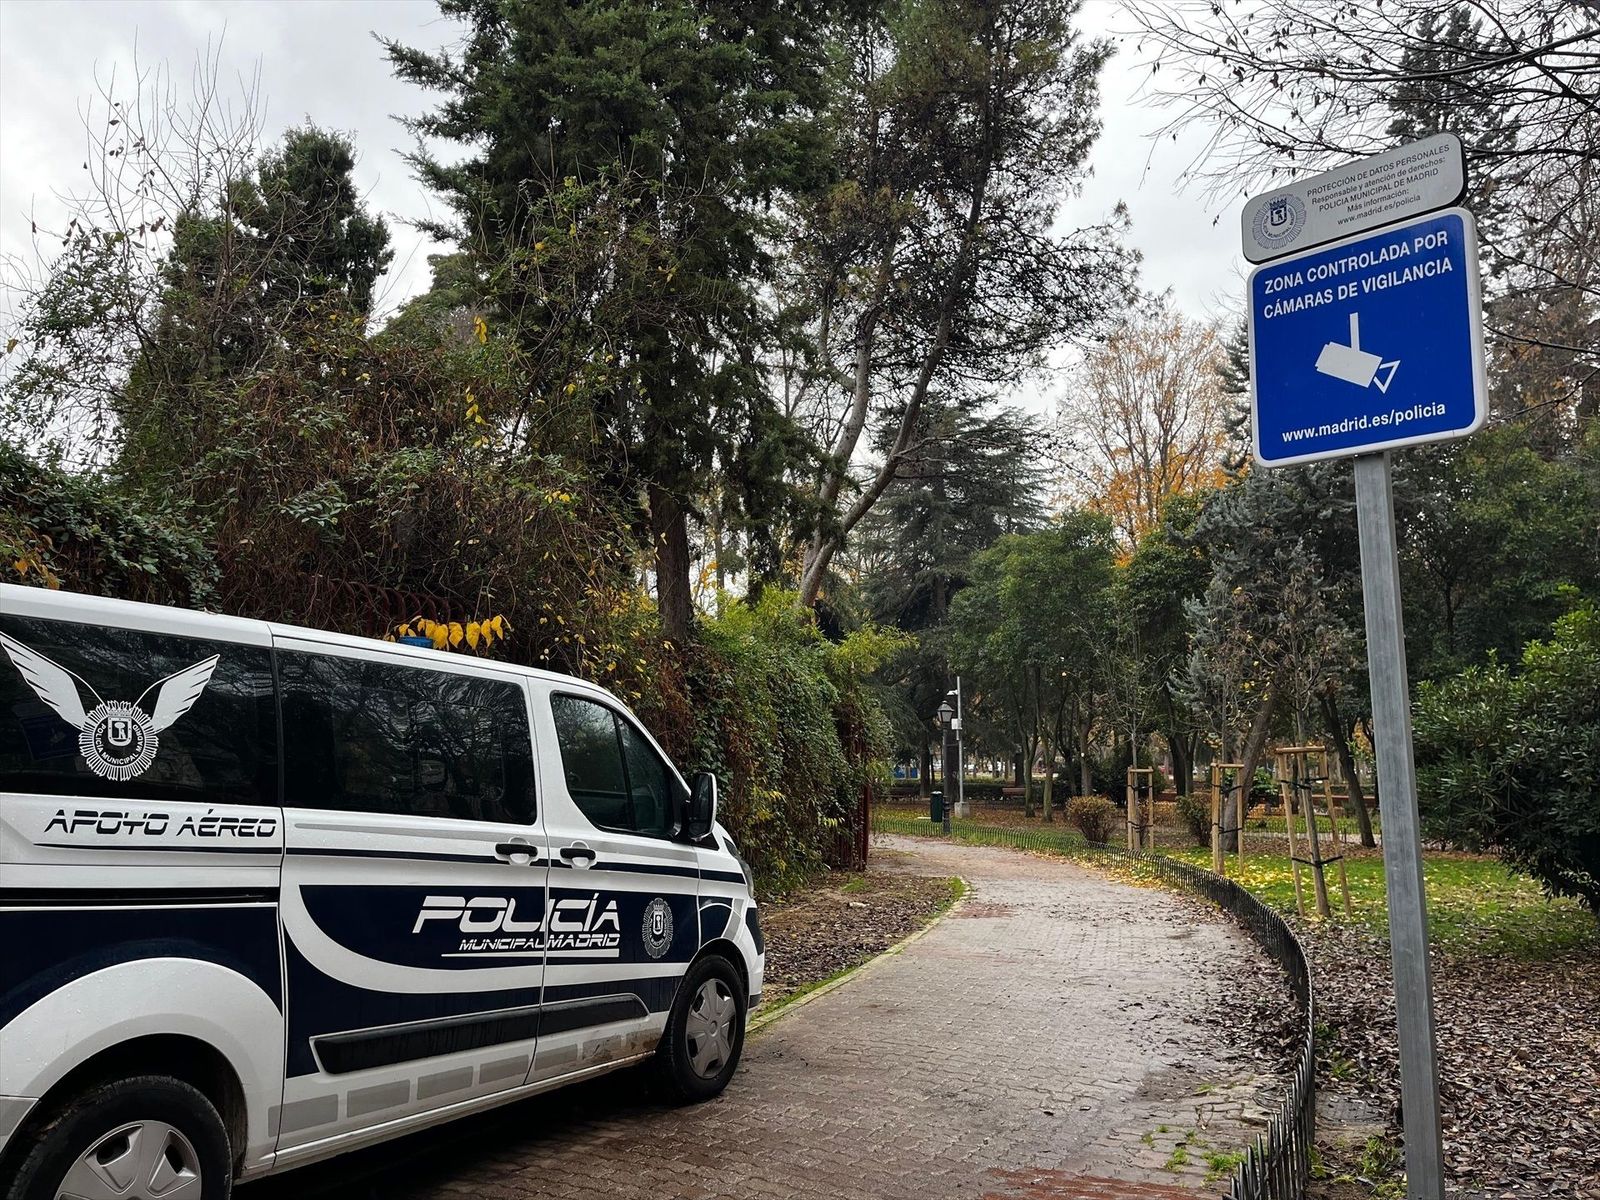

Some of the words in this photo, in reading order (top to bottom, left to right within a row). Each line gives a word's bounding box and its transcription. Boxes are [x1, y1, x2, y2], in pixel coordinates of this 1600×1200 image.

[1307, 175, 1356, 197] PROTECCIÓN
[1357, 170, 1368, 181] DE
[1369, 164, 1395, 177] DATOS
[1396, 144, 1450, 168] PERSONALES
[1311, 186, 1358, 205] Responsable
[1364, 173, 1396, 188] atención
[1397, 170, 1407, 178] de
[1408, 156, 1446, 174] derechos:
[1319, 197, 1349, 212] POLICIA
[1350, 184, 1393, 202] MUNICIPAL
[1394, 178, 1405, 188] DE
[1406, 168, 1439, 184] MADRID
[1337, 195, 1421, 225] www.madrid.es/policia
[1347, 203, 1363, 213] Más
[1364, 189, 1410, 208] información:
[1264, 274, 1304, 295] ZONA
[1306, 241, 1410, 283] CONTROLADA
[1414, 230, 1448, 253] POR
[1263, 288, 1333, 319] CÁMARAS
[1338, 282, 1358, 301] DE
[1362, 257, 1453, 294] VIGILANCIA
[1282, 403, 1446, 442] www.madrid.es/policia
[101, 752, 139, 765] MUNICIPAL
[132, 724, 144, 752] MADRID
[44, 809, 169, 836] APOYO
[176, 808, 277, 838] AÉREO
[412, 893, 620, 934] POLICÍA
[459, 938, 545, 951] MUNICIPAL
[546, 933, 620, 949] MADRID
